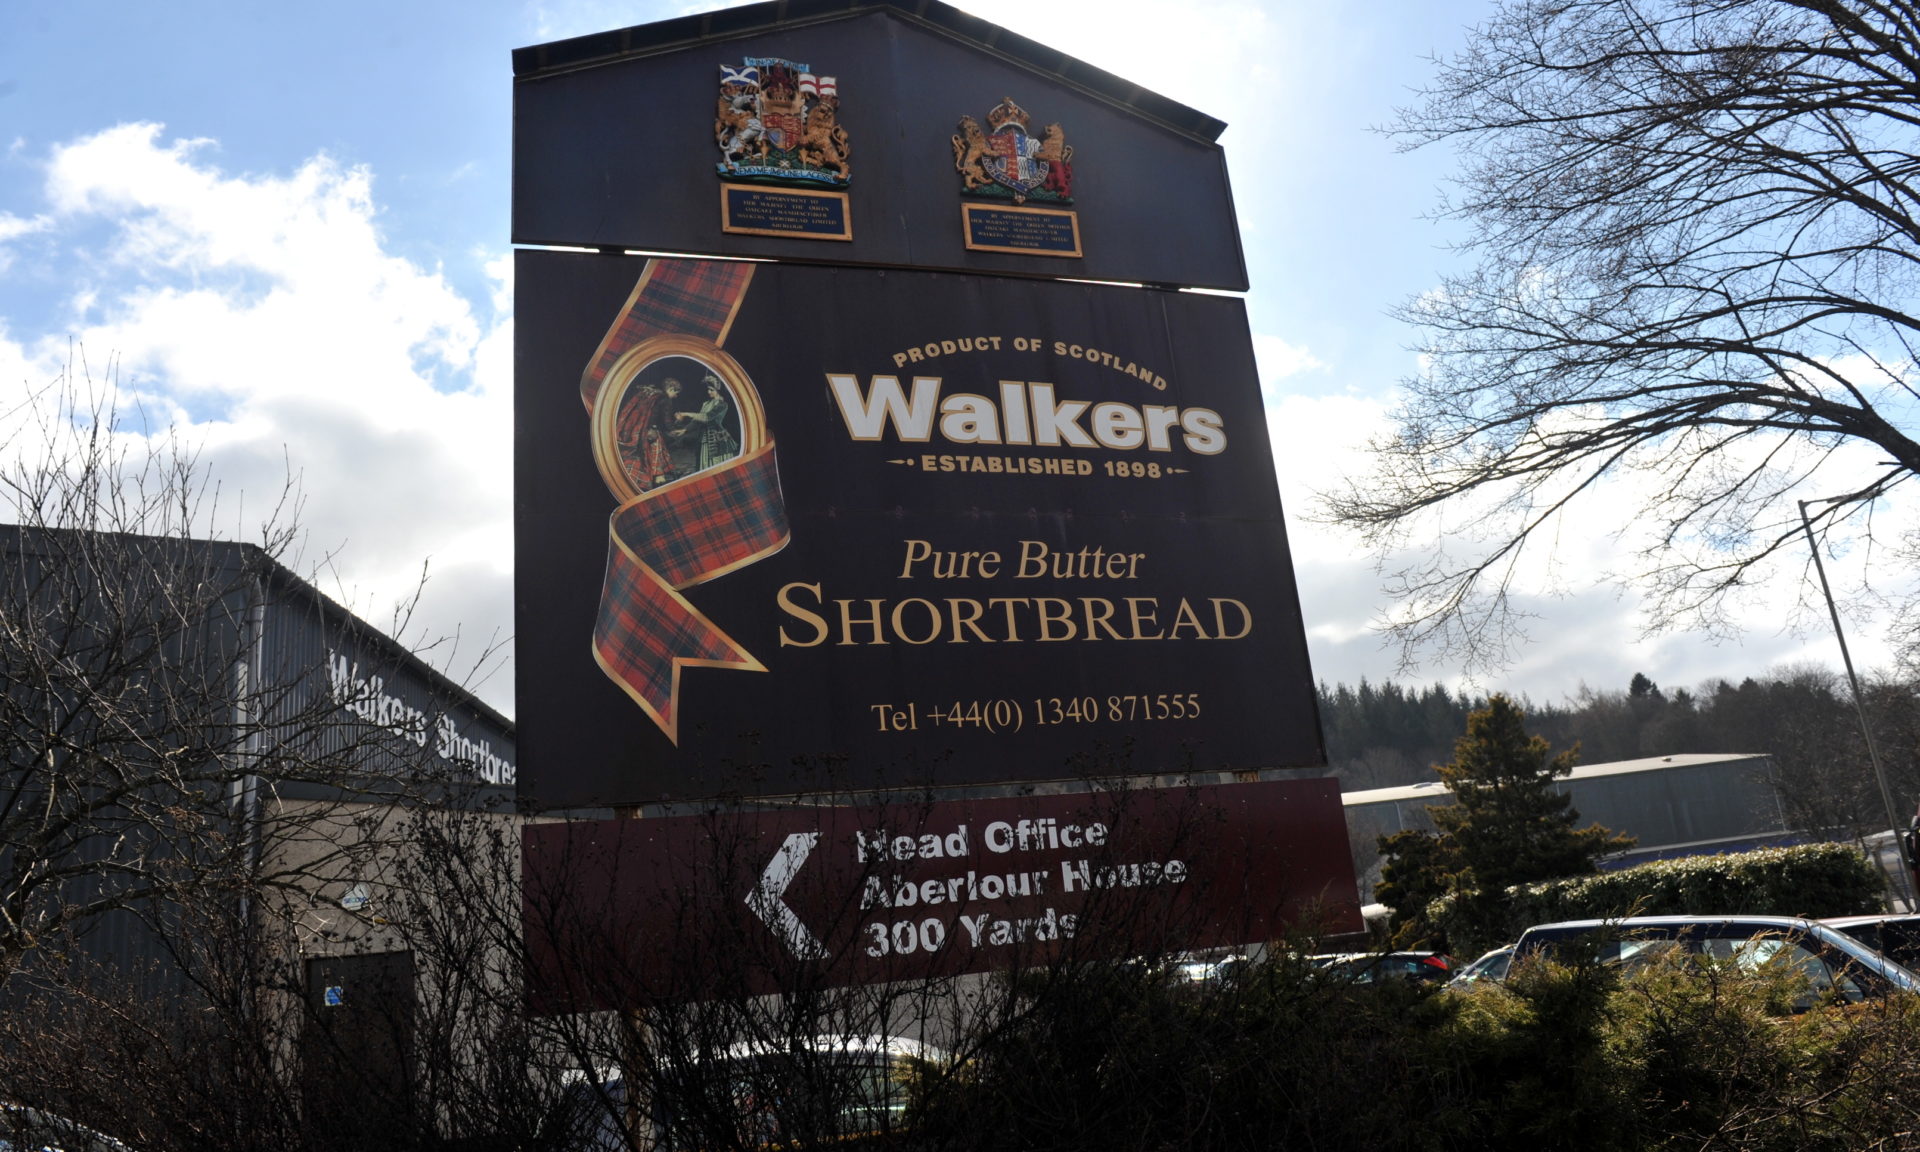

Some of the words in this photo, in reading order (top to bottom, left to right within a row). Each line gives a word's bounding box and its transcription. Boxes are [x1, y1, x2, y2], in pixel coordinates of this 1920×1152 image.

[892, 336, 1001, 368] PRODUCT
[1014, 338, 1042, 352] OF
[1054, 341, 1167, 392] SCOTLAND
[825, 373, 1227, 455] Walkers
[922, 455, 1093, 476] ESTABLISHED
[1104, 460, 1161, 479] 1898
[897, 539, 1001, 580] Pure
[1014, 540, 1145, 580] Butter
[776, 581, 1253, 648] SHORTBREAD
[870, 703, 918, 732] Tel
[926, 699, 1024, 734] +44(0)
[1035, 696, 1099, 725] 1340
[1108, 693, 1201, 722] 871555
[856, 824, 970, 864] Head
[984, 817, 1109, 854] Office
[859, 869, 1049, 910] Aberlour
[1061, 858, 1188, 894] House
[864, 918, 946, 958] 300
[959, 907, 1077, 949] Yards
